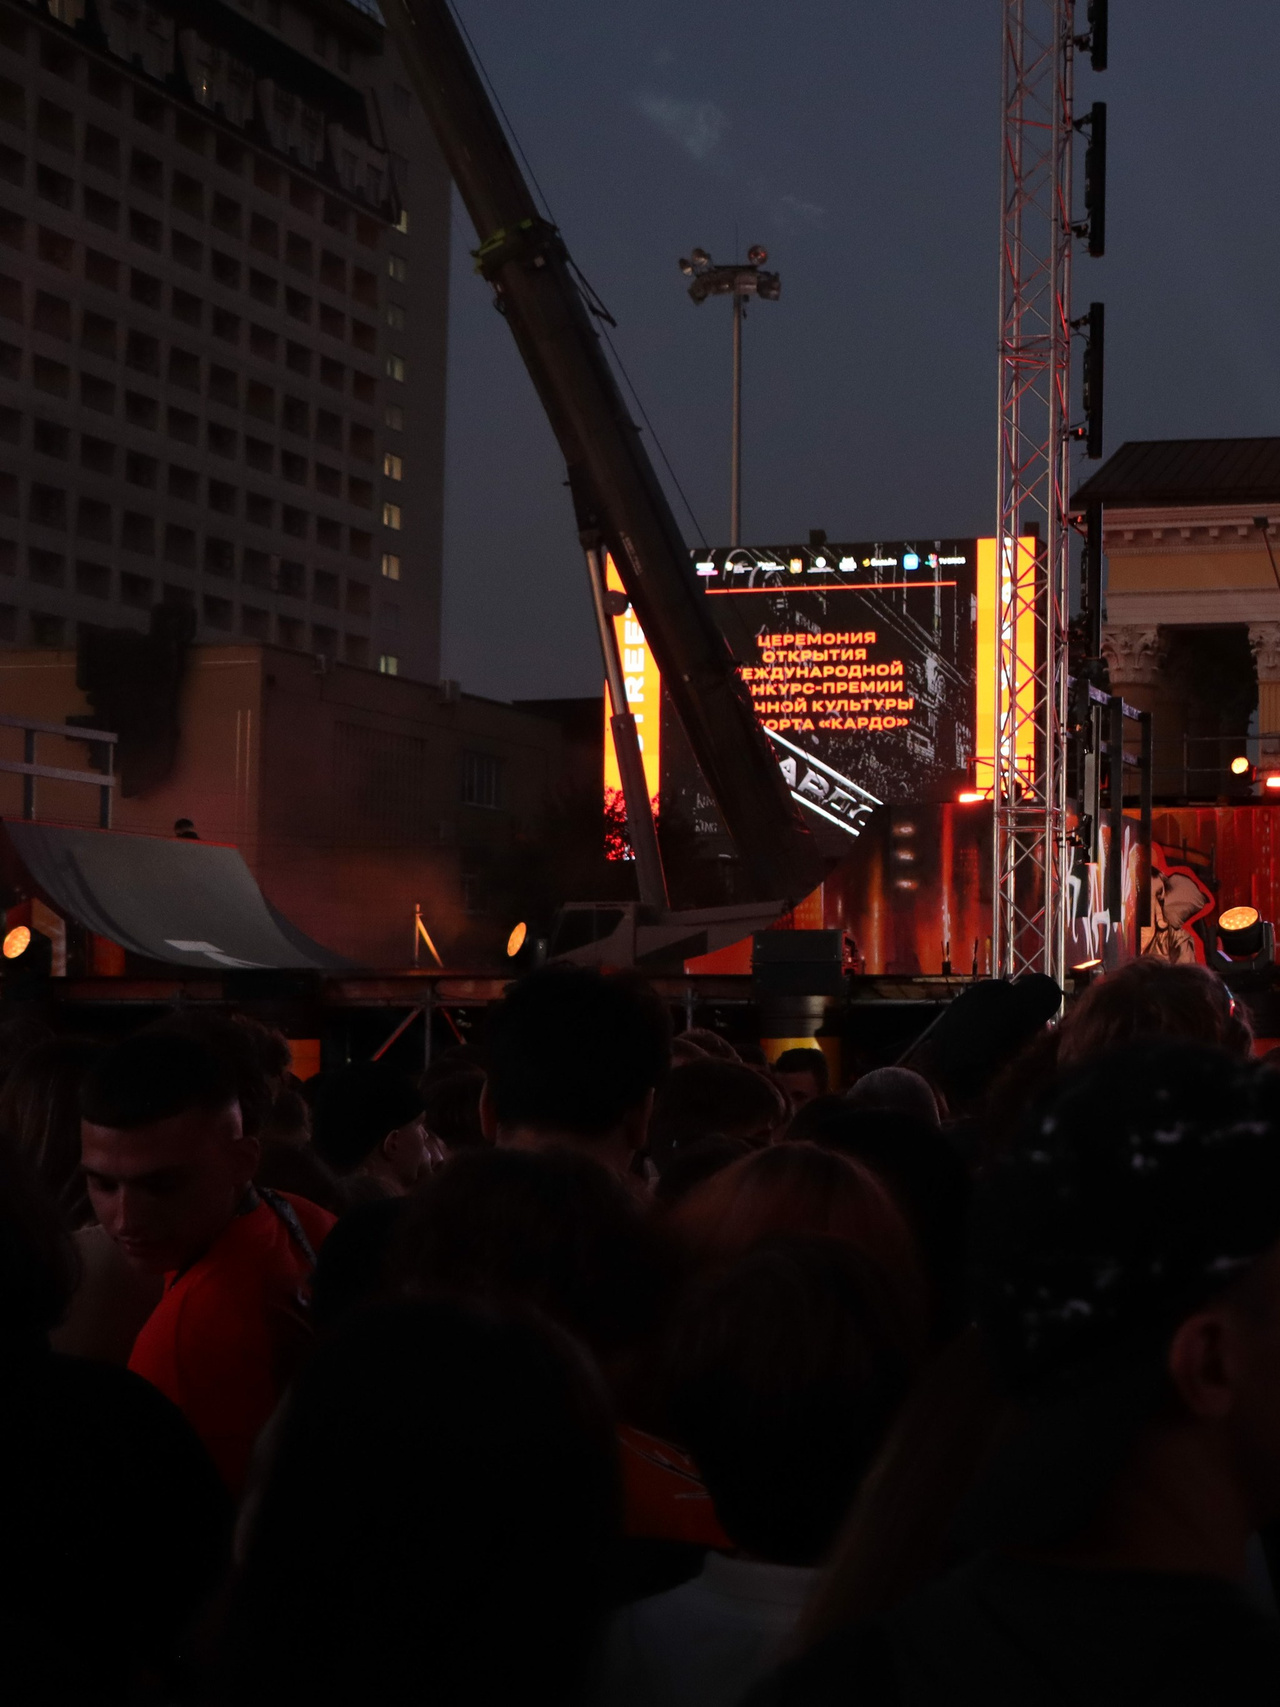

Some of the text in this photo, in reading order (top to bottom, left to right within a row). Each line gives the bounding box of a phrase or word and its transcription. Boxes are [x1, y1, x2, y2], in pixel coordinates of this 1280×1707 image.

[757, 631, 877, 649] ЦЕРЕМОНИЯ
[762, 648, 867, 664] ОТКРЫТИЯ
[738, 660, 904, 681] ЕЖДУНАРОДНОЙ
[750, 680, 904, 696] НКУРС-ПРЕМИИ
[754, 696, 914, 713] ЧНОЙ КУЛЬТУРЫ
[761, 715, 909, 732] ОРТА «КАРДО»
